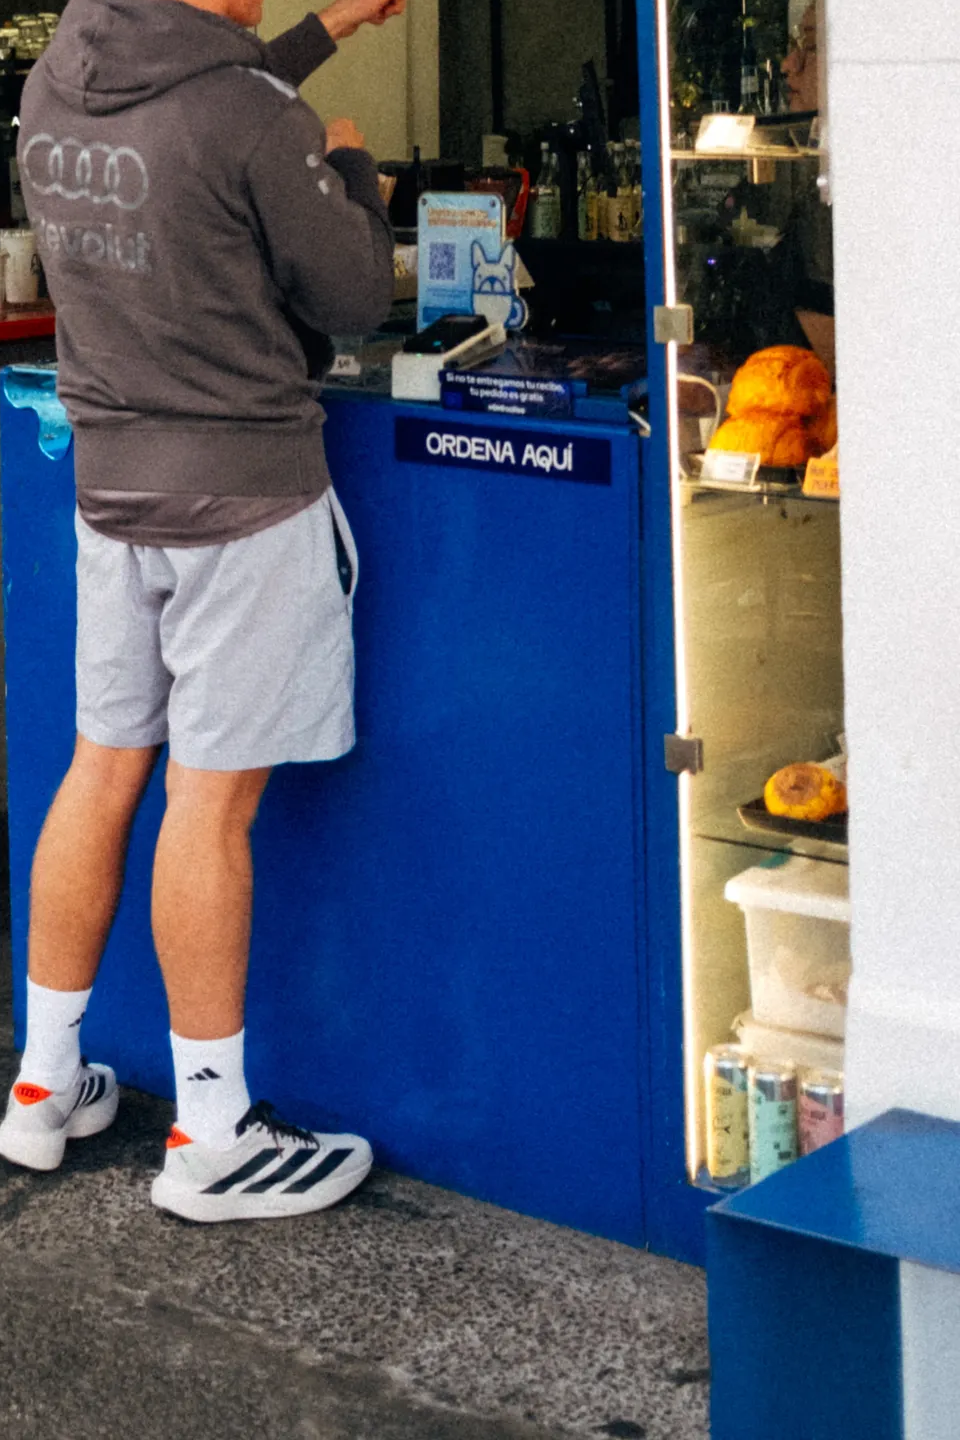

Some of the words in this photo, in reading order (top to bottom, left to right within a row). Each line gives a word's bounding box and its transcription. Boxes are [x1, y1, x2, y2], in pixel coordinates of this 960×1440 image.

[445, 372, 455, 383] Si
[455, 374, 466, 383] no
[466, 374, 476, 384] te
[476, 376, 525, 390] entregamos
[526, 380, 536, 390] tu
[469, 387, 479, 397] tu
[479, 388, 508, 399] pedido
[519, 391, 544, 403] gratis
[425, 431, 515, 465] ORDENA
[521, 441, 573, 473] AQUÍ
